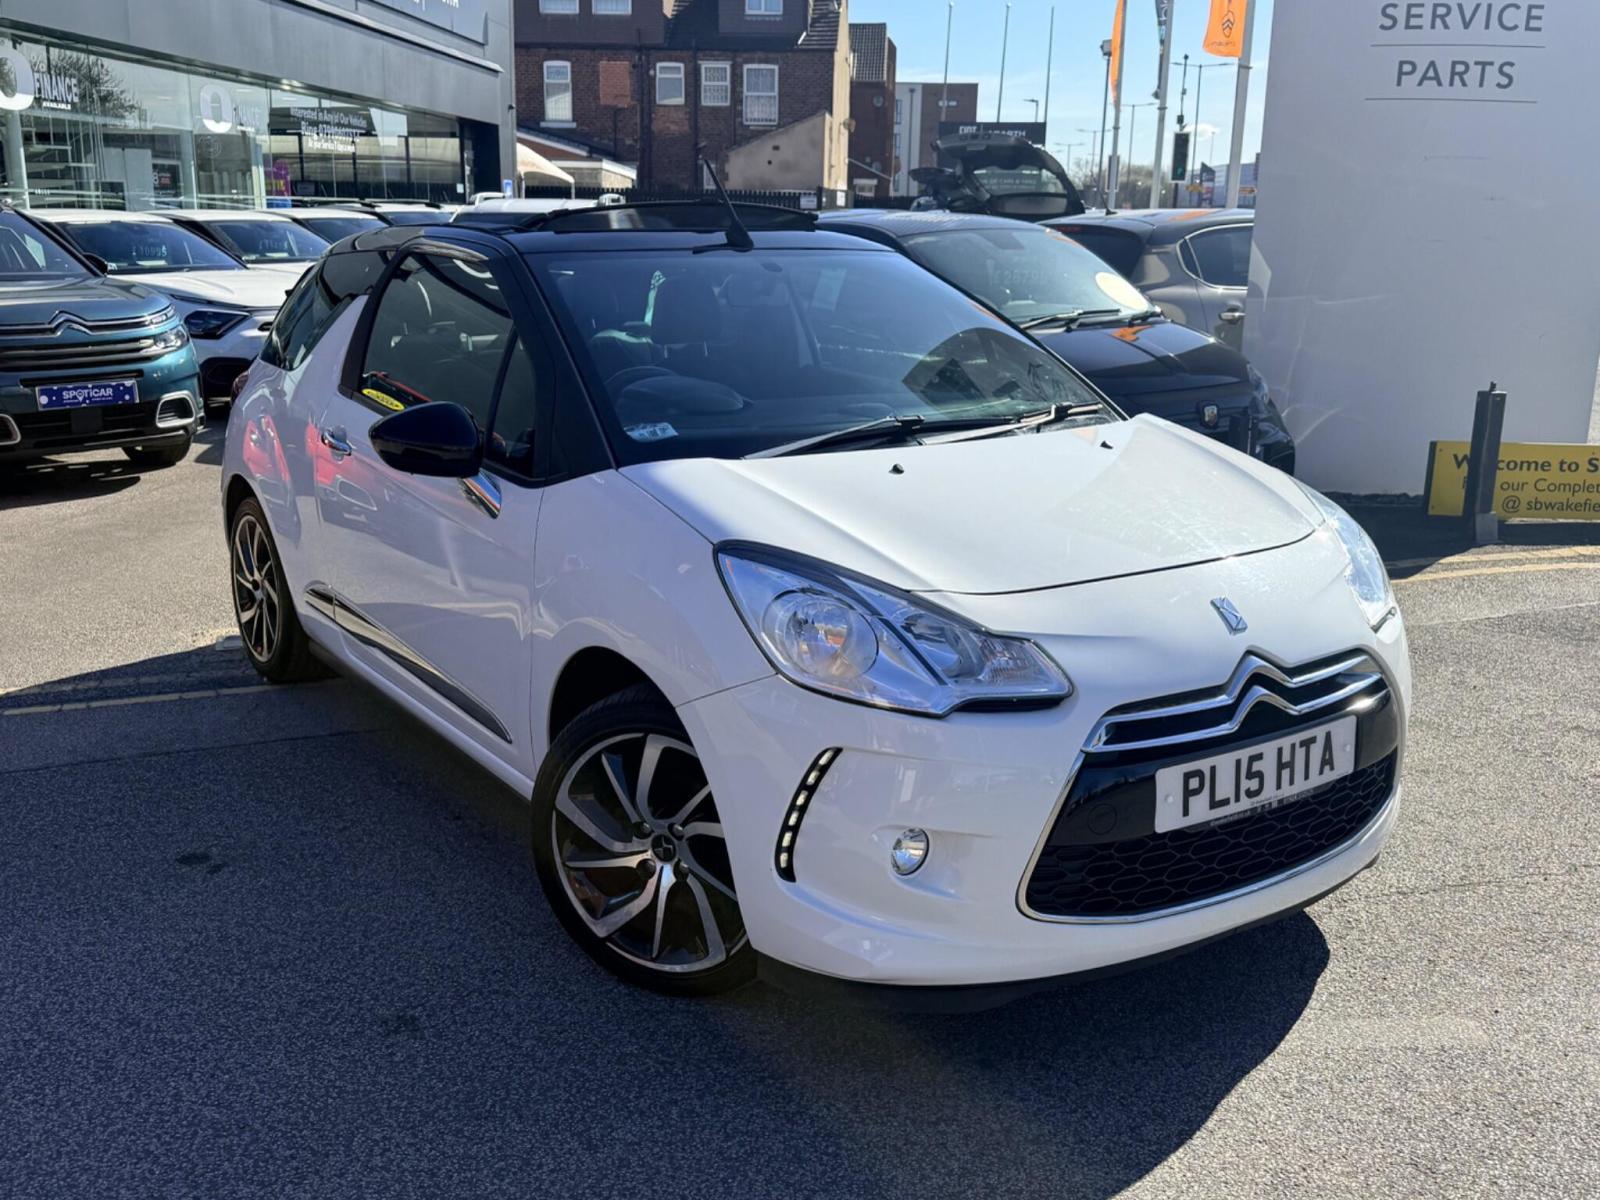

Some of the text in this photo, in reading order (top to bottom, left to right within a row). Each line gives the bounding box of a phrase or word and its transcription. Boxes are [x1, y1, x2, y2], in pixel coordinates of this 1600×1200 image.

[1378, 2, 1545, 32] SERVICE
[33, 72, 80, 102] FINANCE
[1395, 60, 1516, 90] PARTS
[1452, 453, 1551, 473] Wcome
[1559, 459, 1580, 473] to
[1500, 480, 1529, 492] our
[1182, 752, 1265, 818] PL15
[1275, 730, 1335, 791] HTA
